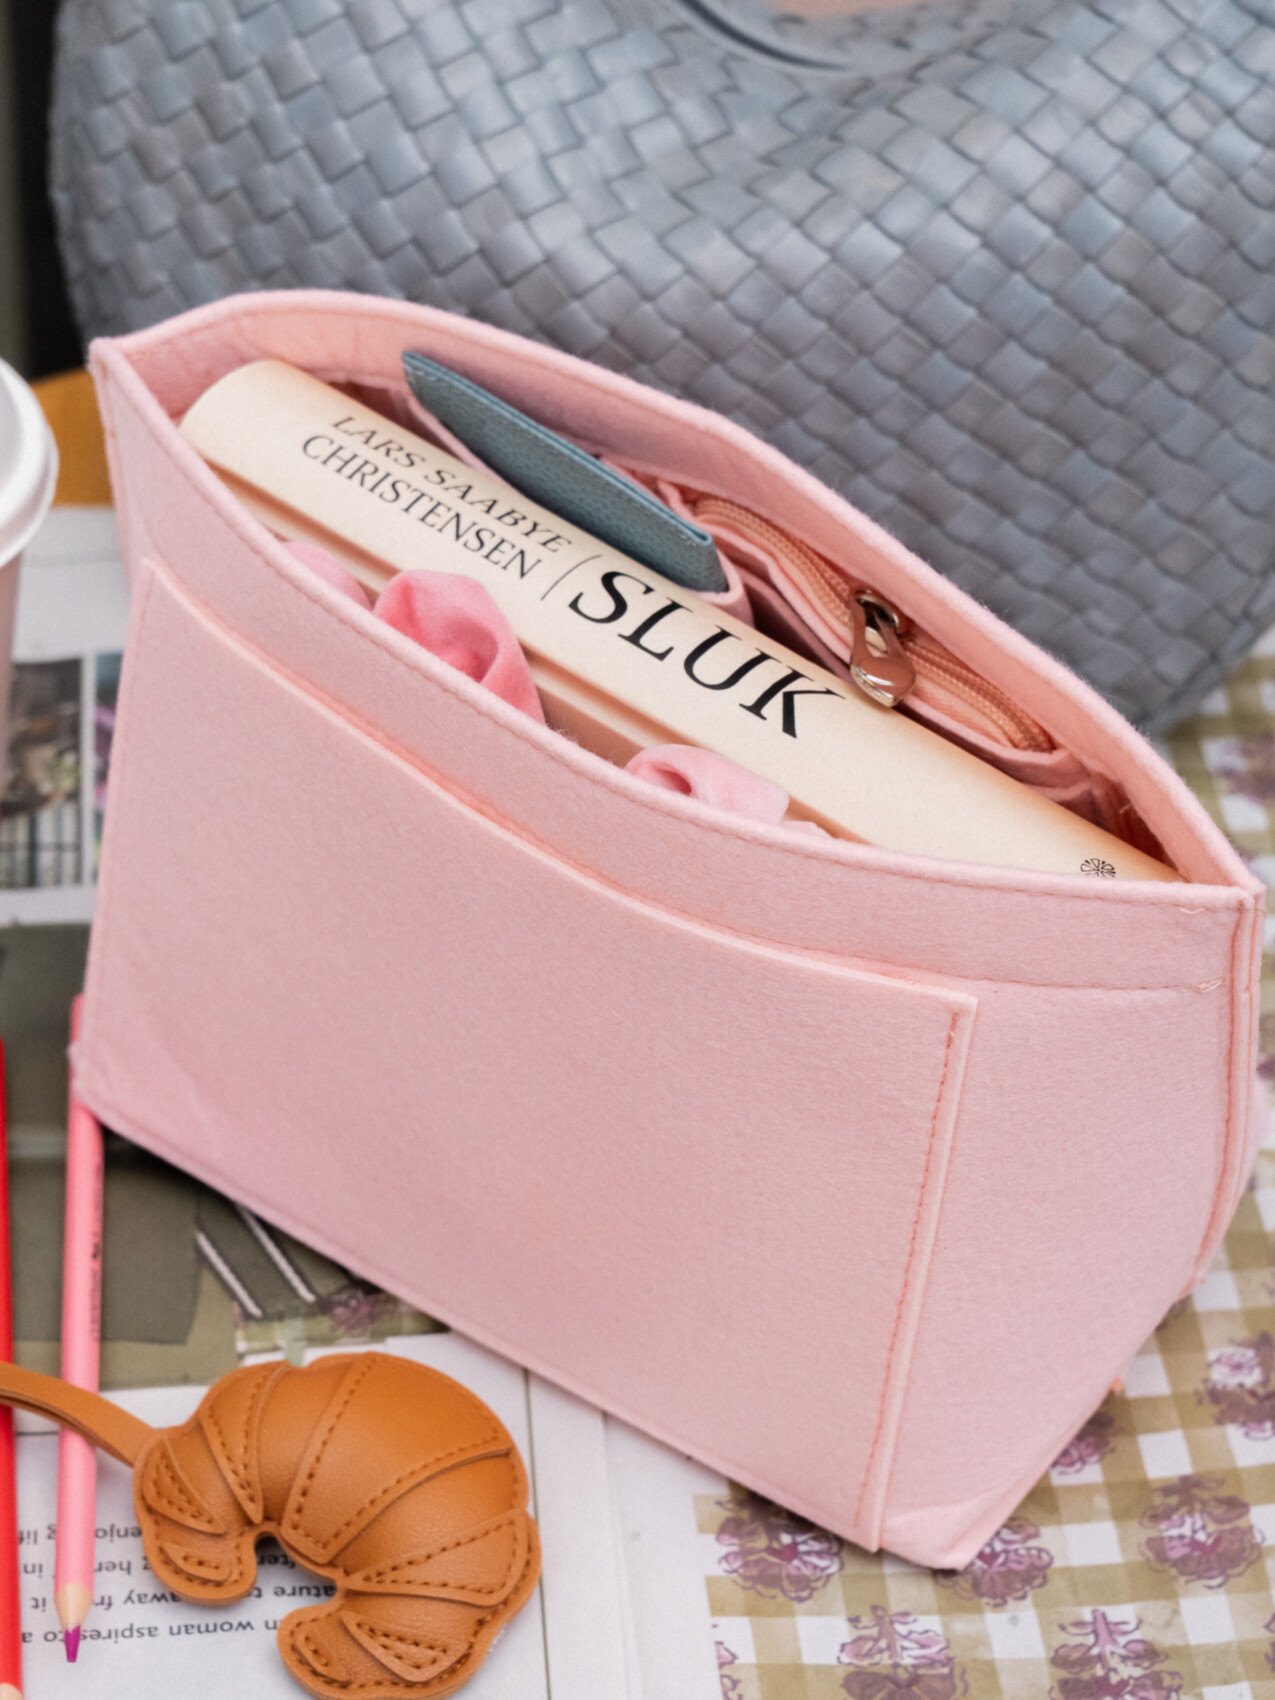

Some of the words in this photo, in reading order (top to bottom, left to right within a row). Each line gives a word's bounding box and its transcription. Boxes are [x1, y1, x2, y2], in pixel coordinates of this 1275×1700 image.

[331, 416, 425, 469] LARS
[424, 469, 572, 554] SAABYE
[301, 433, 543, 580] CHRISTENSEN
[567, 570, 846, 739] SLUK
[23, 1563, 43, 1578] in
[123, 1589, 183, 1605] away
[273, 1586, 336, 1599] ature
[30, 1597, 47, 1612] it
[80, 1622, 158, 1644] aspires
[168, 1620, 255, 1636] woman
